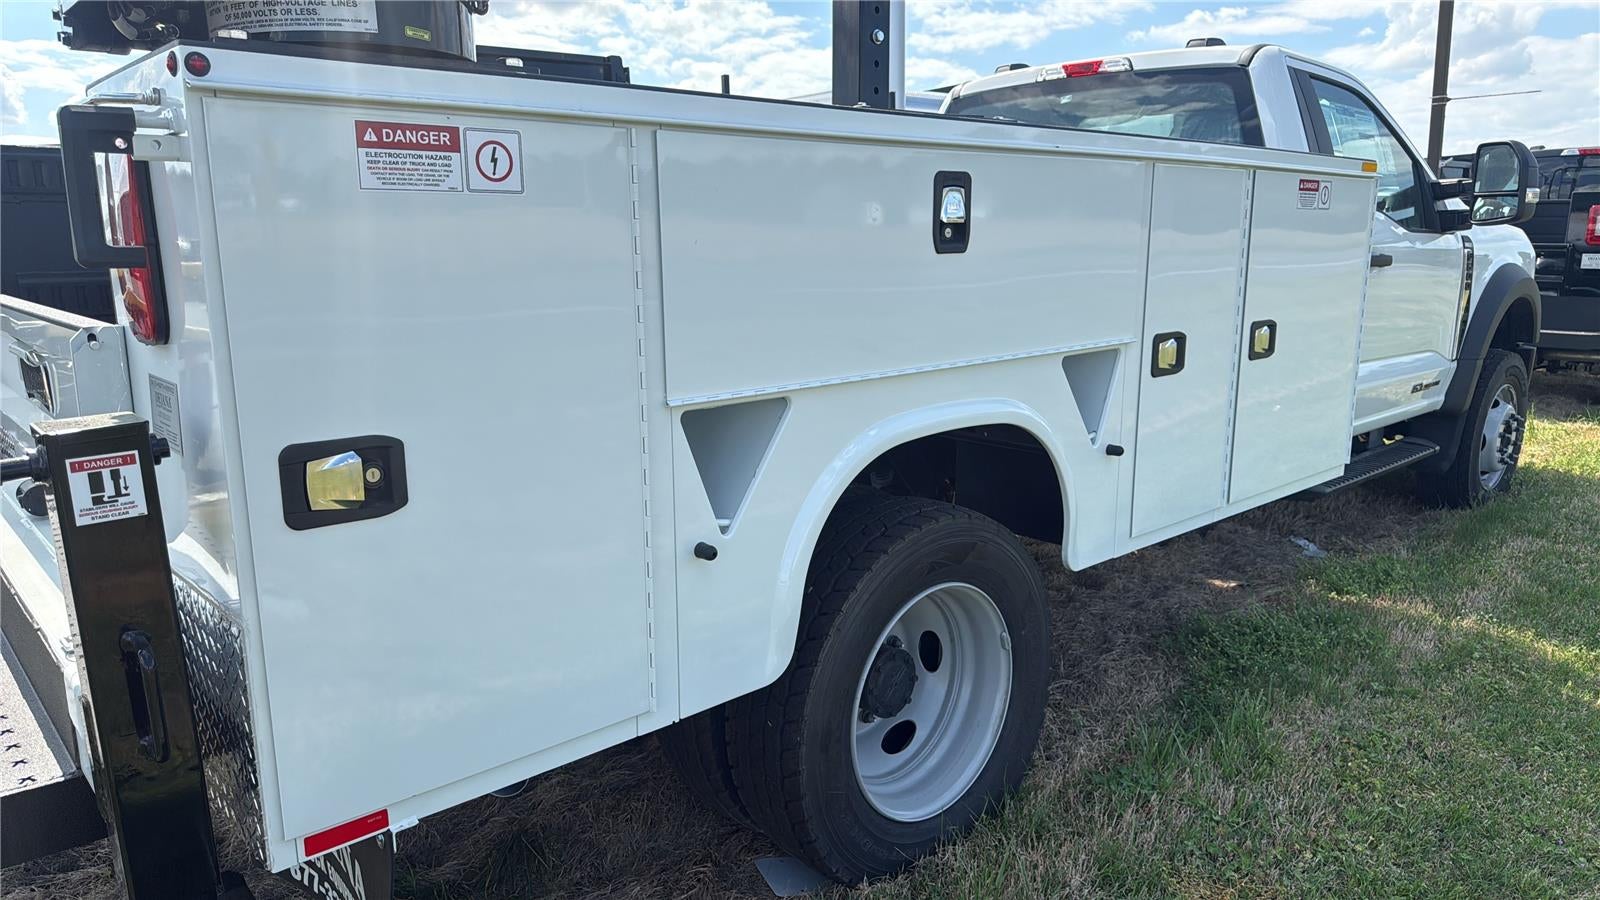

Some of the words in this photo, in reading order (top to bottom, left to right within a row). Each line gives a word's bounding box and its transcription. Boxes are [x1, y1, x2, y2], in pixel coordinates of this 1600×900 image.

[231, 2, 245, 11] FEET
[253, 8, 278, 17] VOLTS
[280, 8, 292, 16] OR
[382, 128, 452, 145] DANGER
[365, 151, 423, 160] ELECTROCUTION
[425, 153, 453, 161] HAZARD
[83, 457, 123, 469] DANGER
